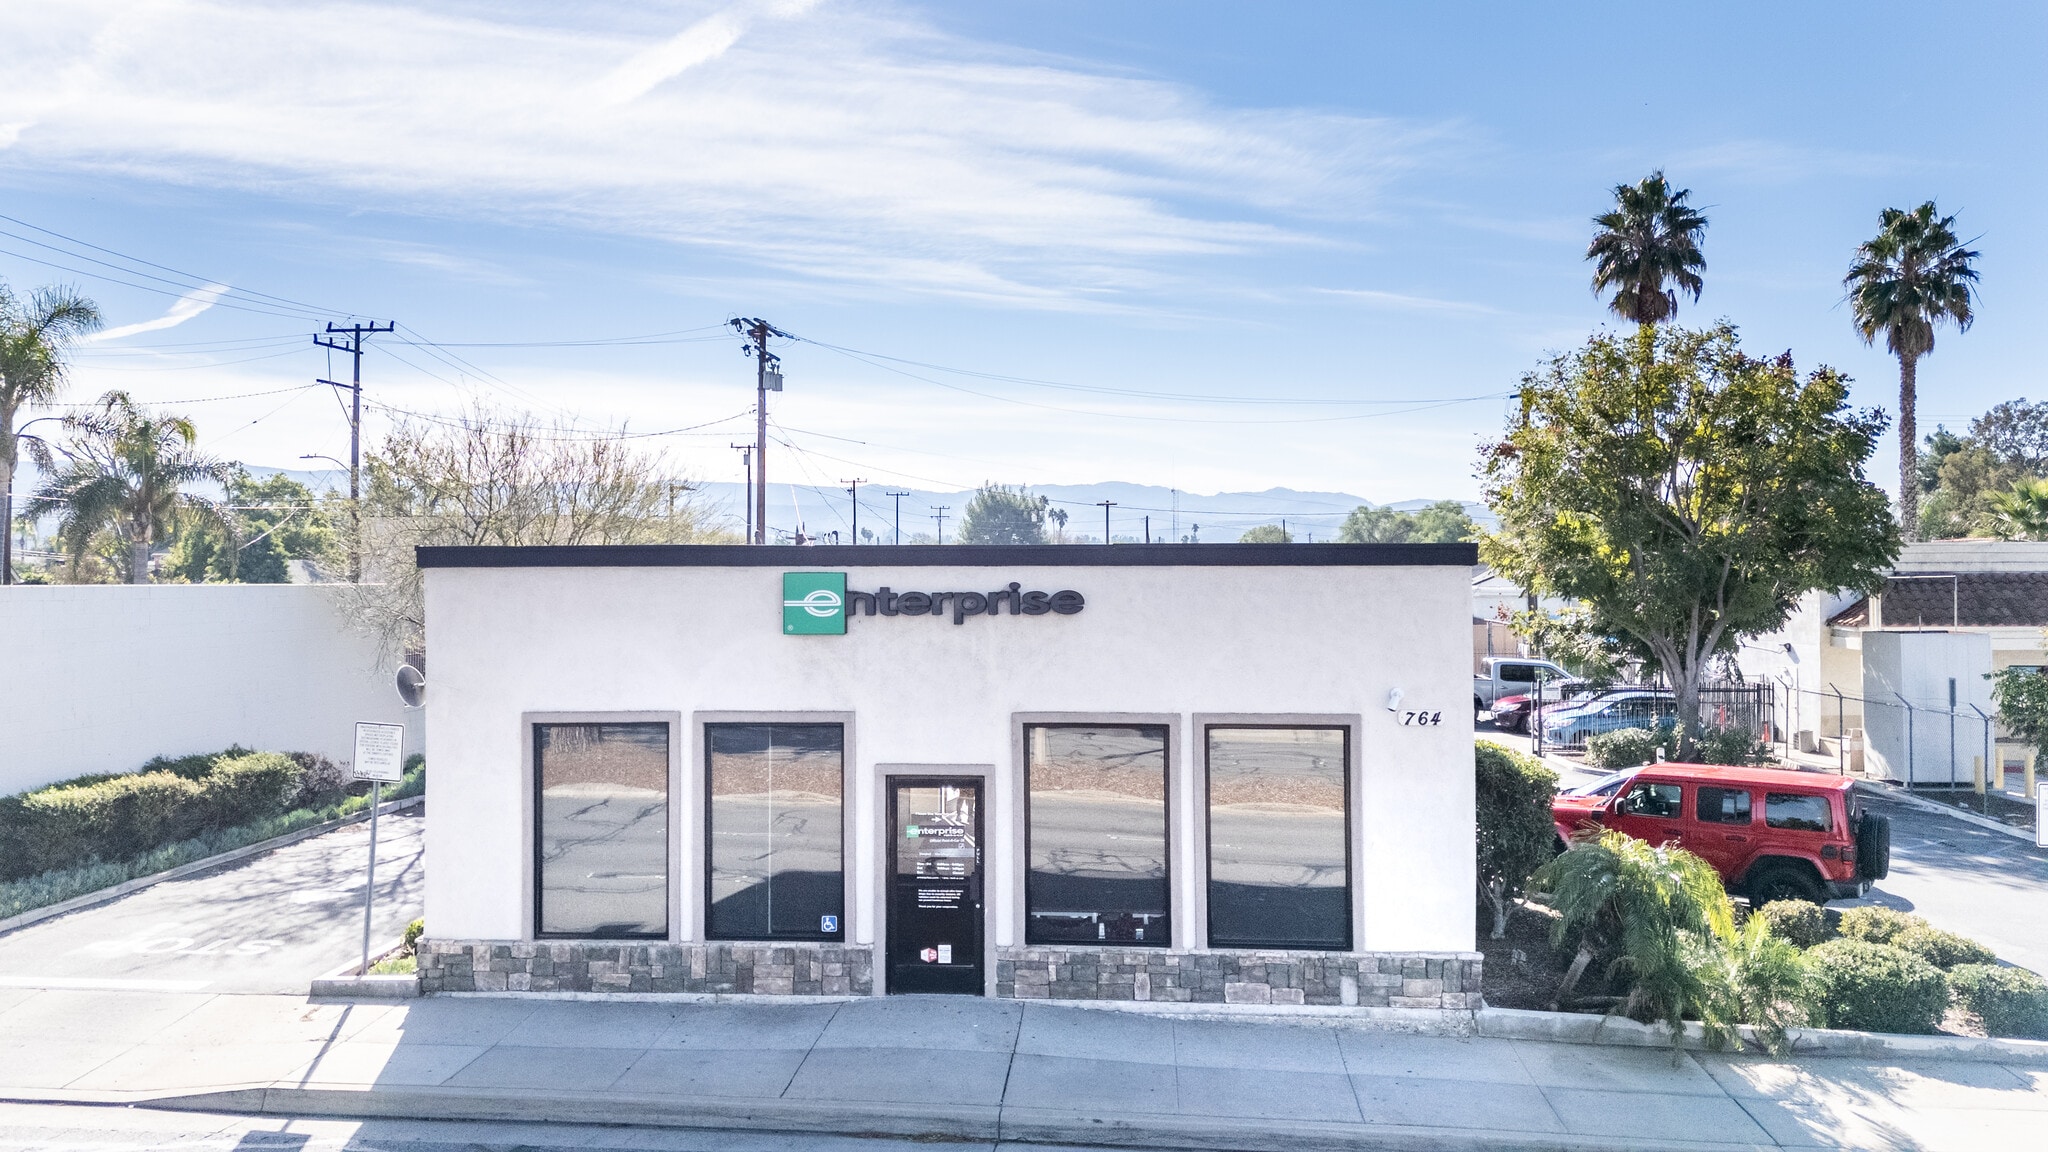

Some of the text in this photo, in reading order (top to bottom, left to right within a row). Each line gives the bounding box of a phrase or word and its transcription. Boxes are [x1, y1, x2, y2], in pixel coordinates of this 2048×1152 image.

[783, 582, 1085, 625] enterprise
[1404, 711, 1442, 726] 764
[907, 827, 964, 836] enterprise
